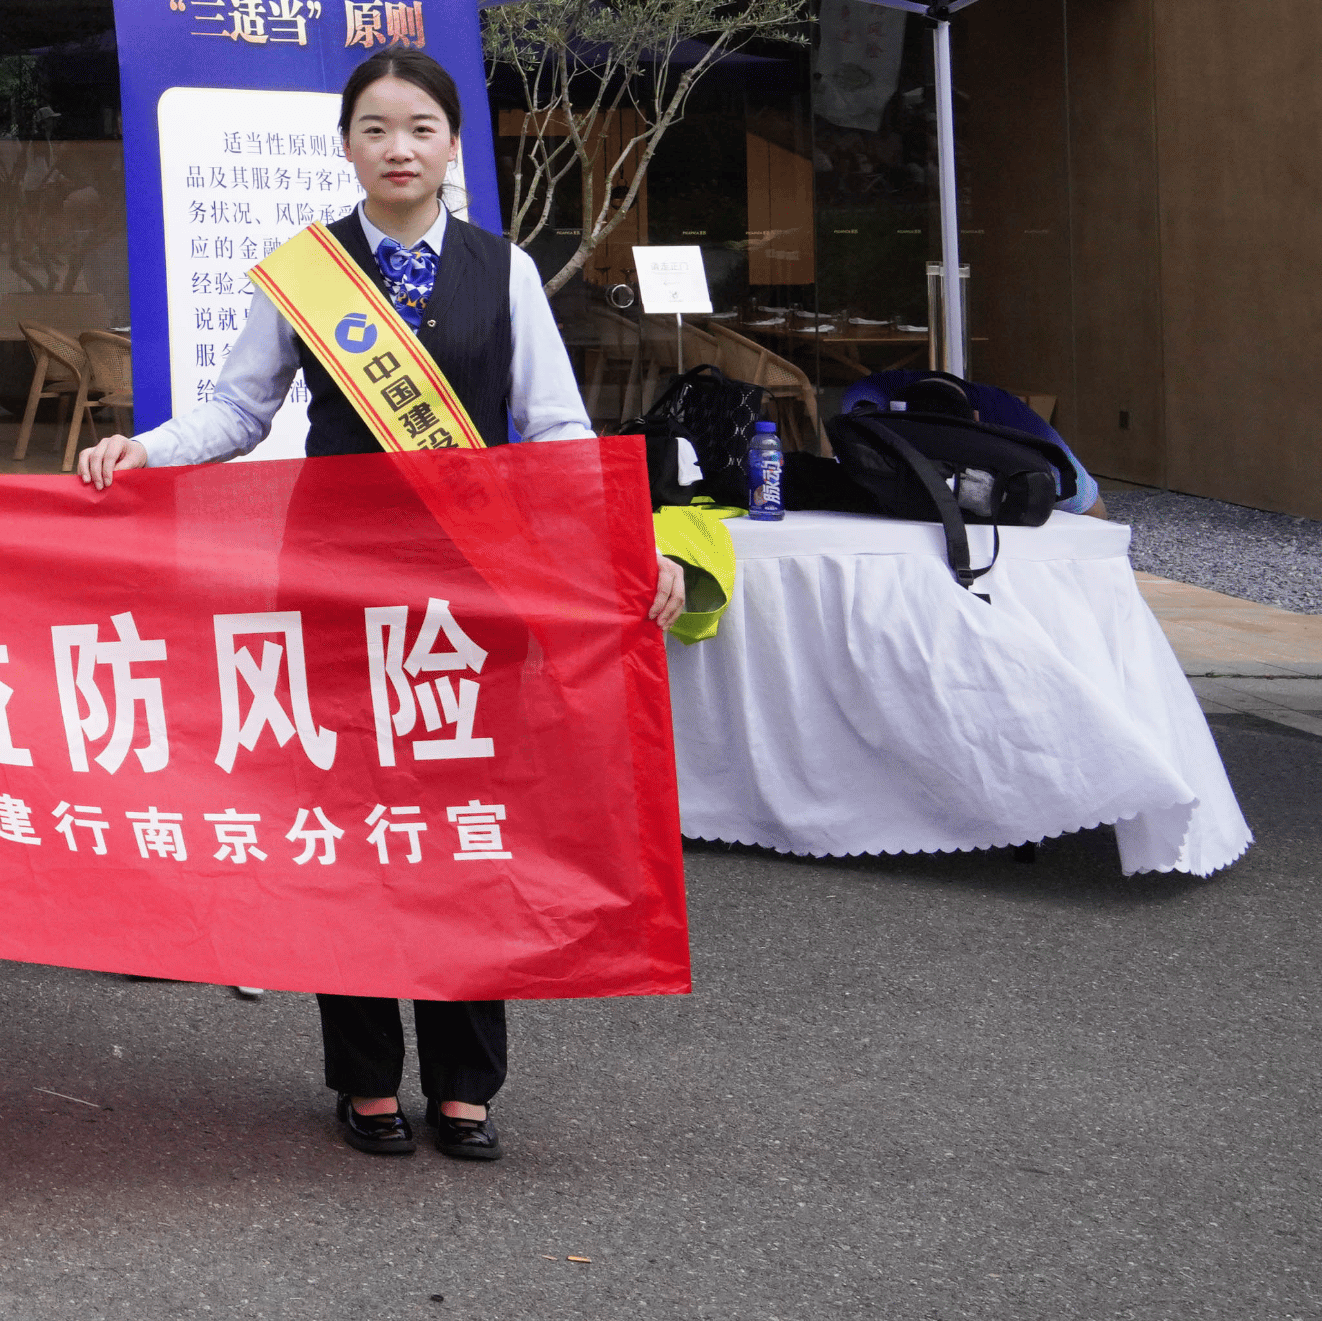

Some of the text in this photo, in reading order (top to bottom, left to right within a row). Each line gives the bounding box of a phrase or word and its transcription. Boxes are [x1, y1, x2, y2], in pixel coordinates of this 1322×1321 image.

[223, 131, 346, 158] 适当性原则是
[762, 460, 783, 506] 脉动
